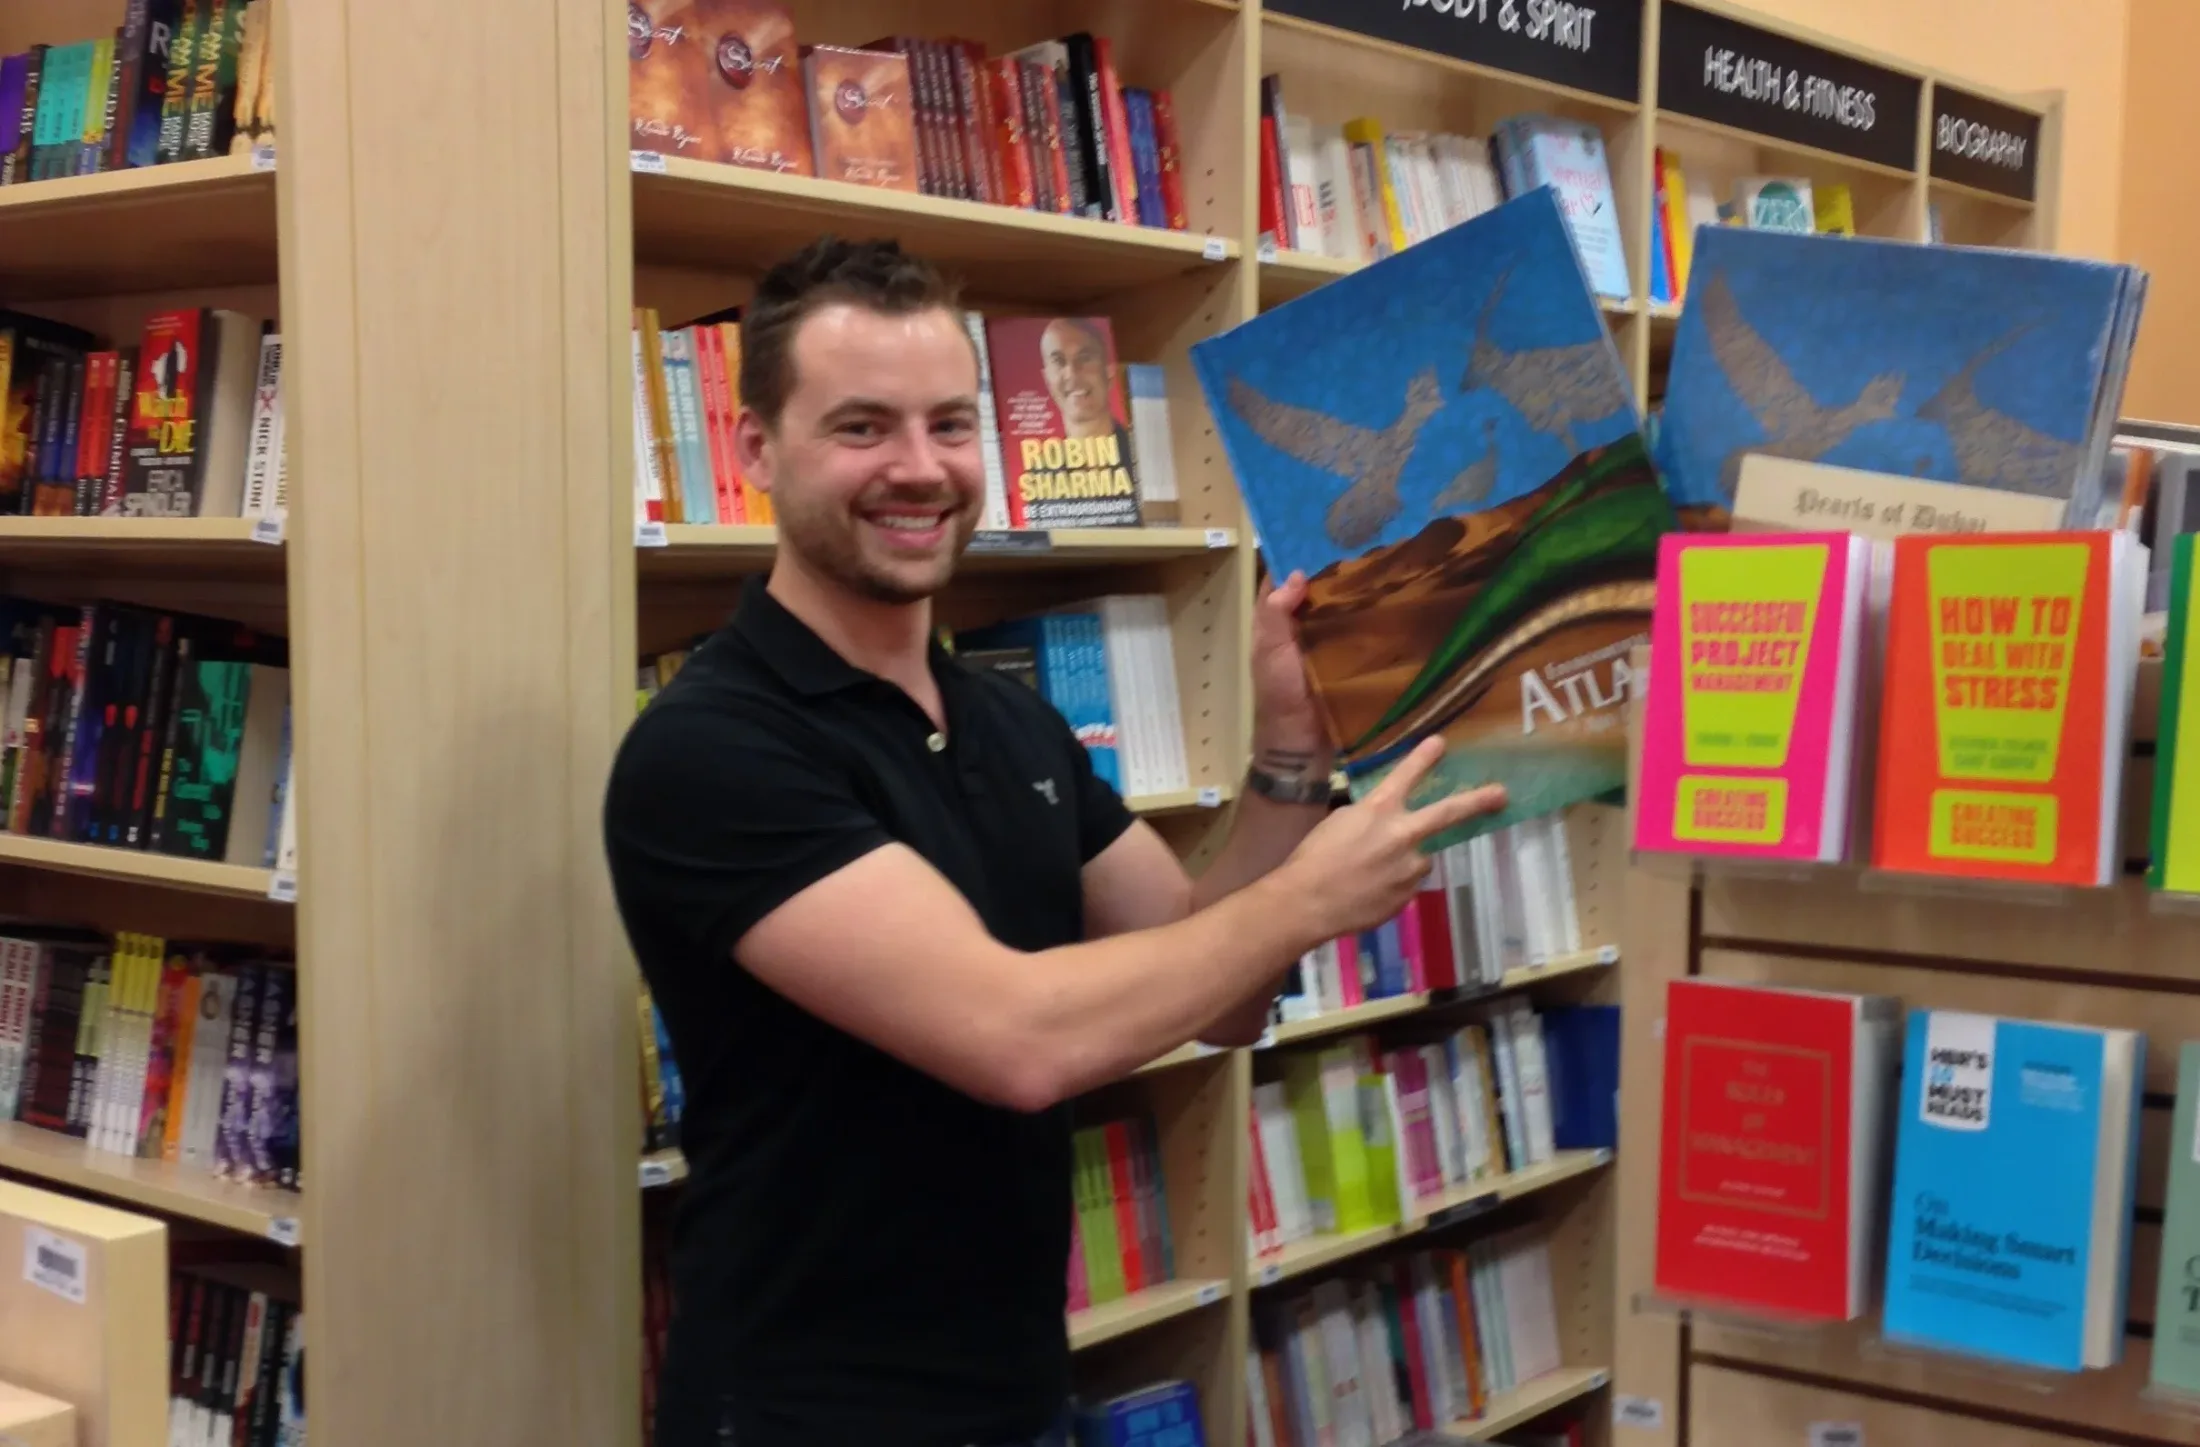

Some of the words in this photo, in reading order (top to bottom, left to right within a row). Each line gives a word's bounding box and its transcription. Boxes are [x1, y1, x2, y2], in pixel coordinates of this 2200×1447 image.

[1412, 0, 1488, 24] DY
[1497, 0, 1521, 33] &
[1525, 0, 1596, 52] SPIRIT
[1703, 45, 1782, 105] HEALTH
[1782, 70, 1801, 111] &
[1802, 75, 1876, 131] FITNESS
[1936, 113, 2027, 171] BIOGRAPHY
[1020, 435, 1121, 470] ROBIN
[1018, 467, 1134, 501] SHARMA
[1939, 596, 2020, 635] HOW
[2031, 596, 2073, 635] TO
[1691, 640, 1800, 667] PROJECT
[1942, 641, 1996, 670] DEAL
[2004, 642, 2065, 670] WITH
[1520, 658, 1648, 736] ATLA
[1944, 676, 2060, 711] STRESS
[1928, 1084, 1986, 1103] MUST
[1915, 1217, 1999, 1253] Making
